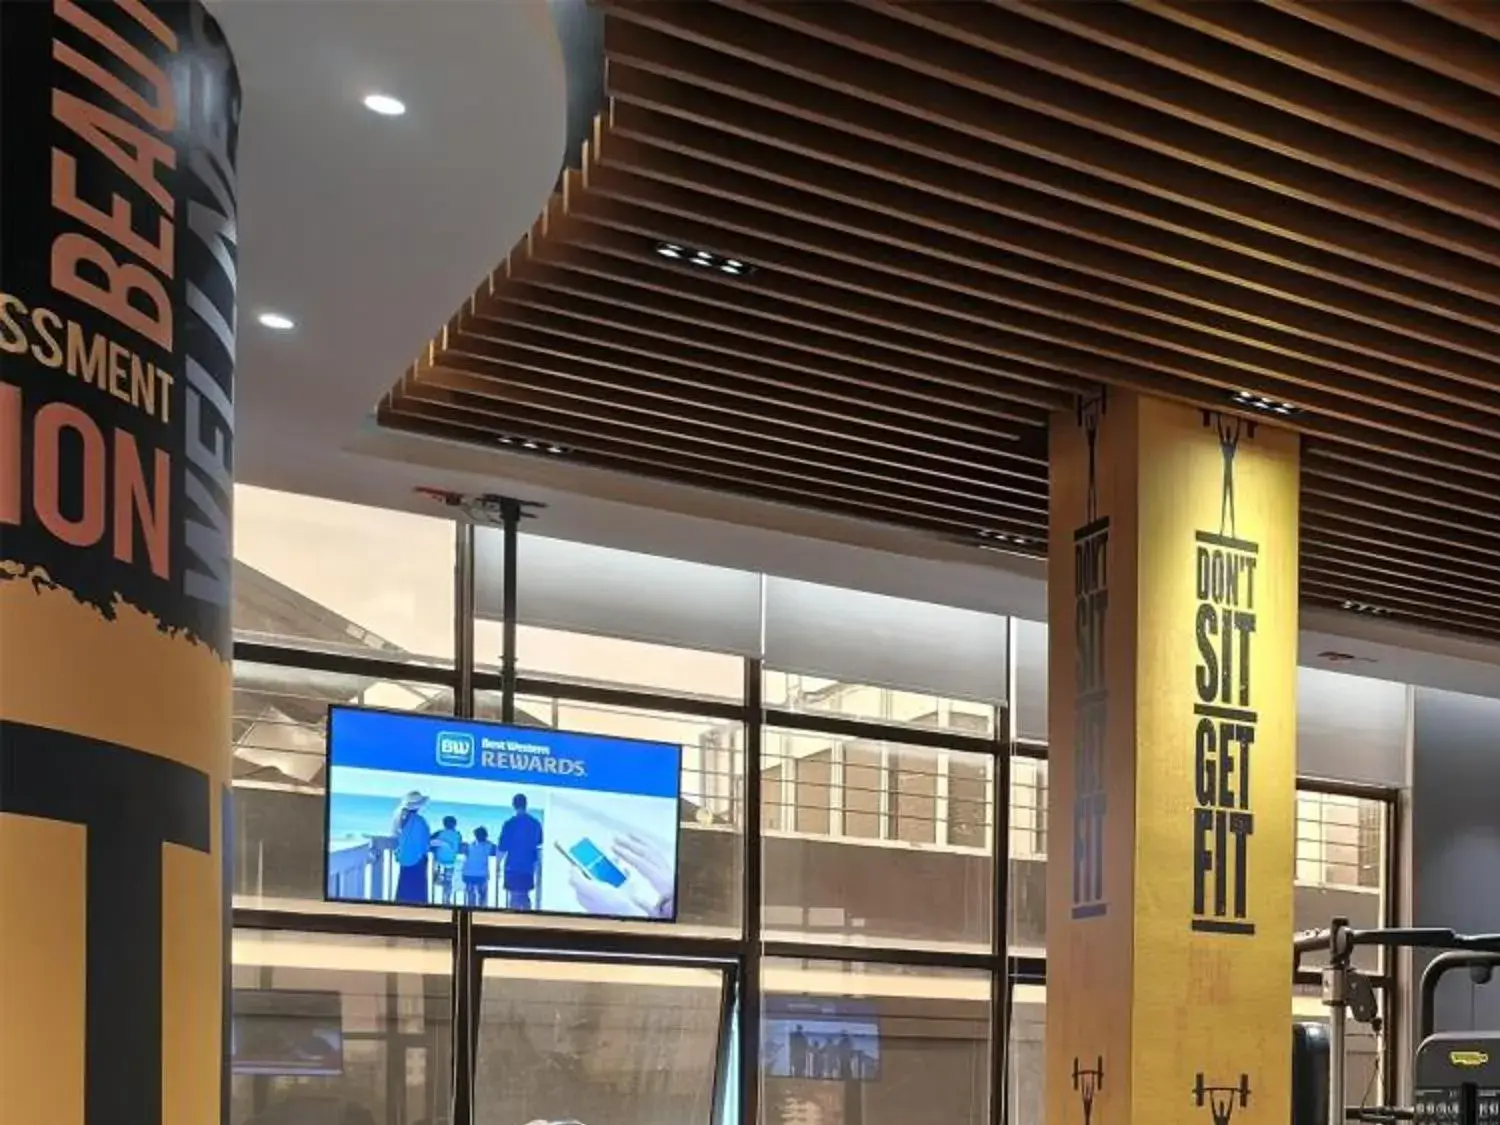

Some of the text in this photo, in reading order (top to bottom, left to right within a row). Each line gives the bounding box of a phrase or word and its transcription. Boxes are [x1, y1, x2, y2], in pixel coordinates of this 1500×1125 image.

[1196, 546, 1257, 609] DON'T
[1195, 603, 1256, 708] SIT
[1194, 718, 1255, 810] GET
[1193, 807, 1254, 919] FIT
